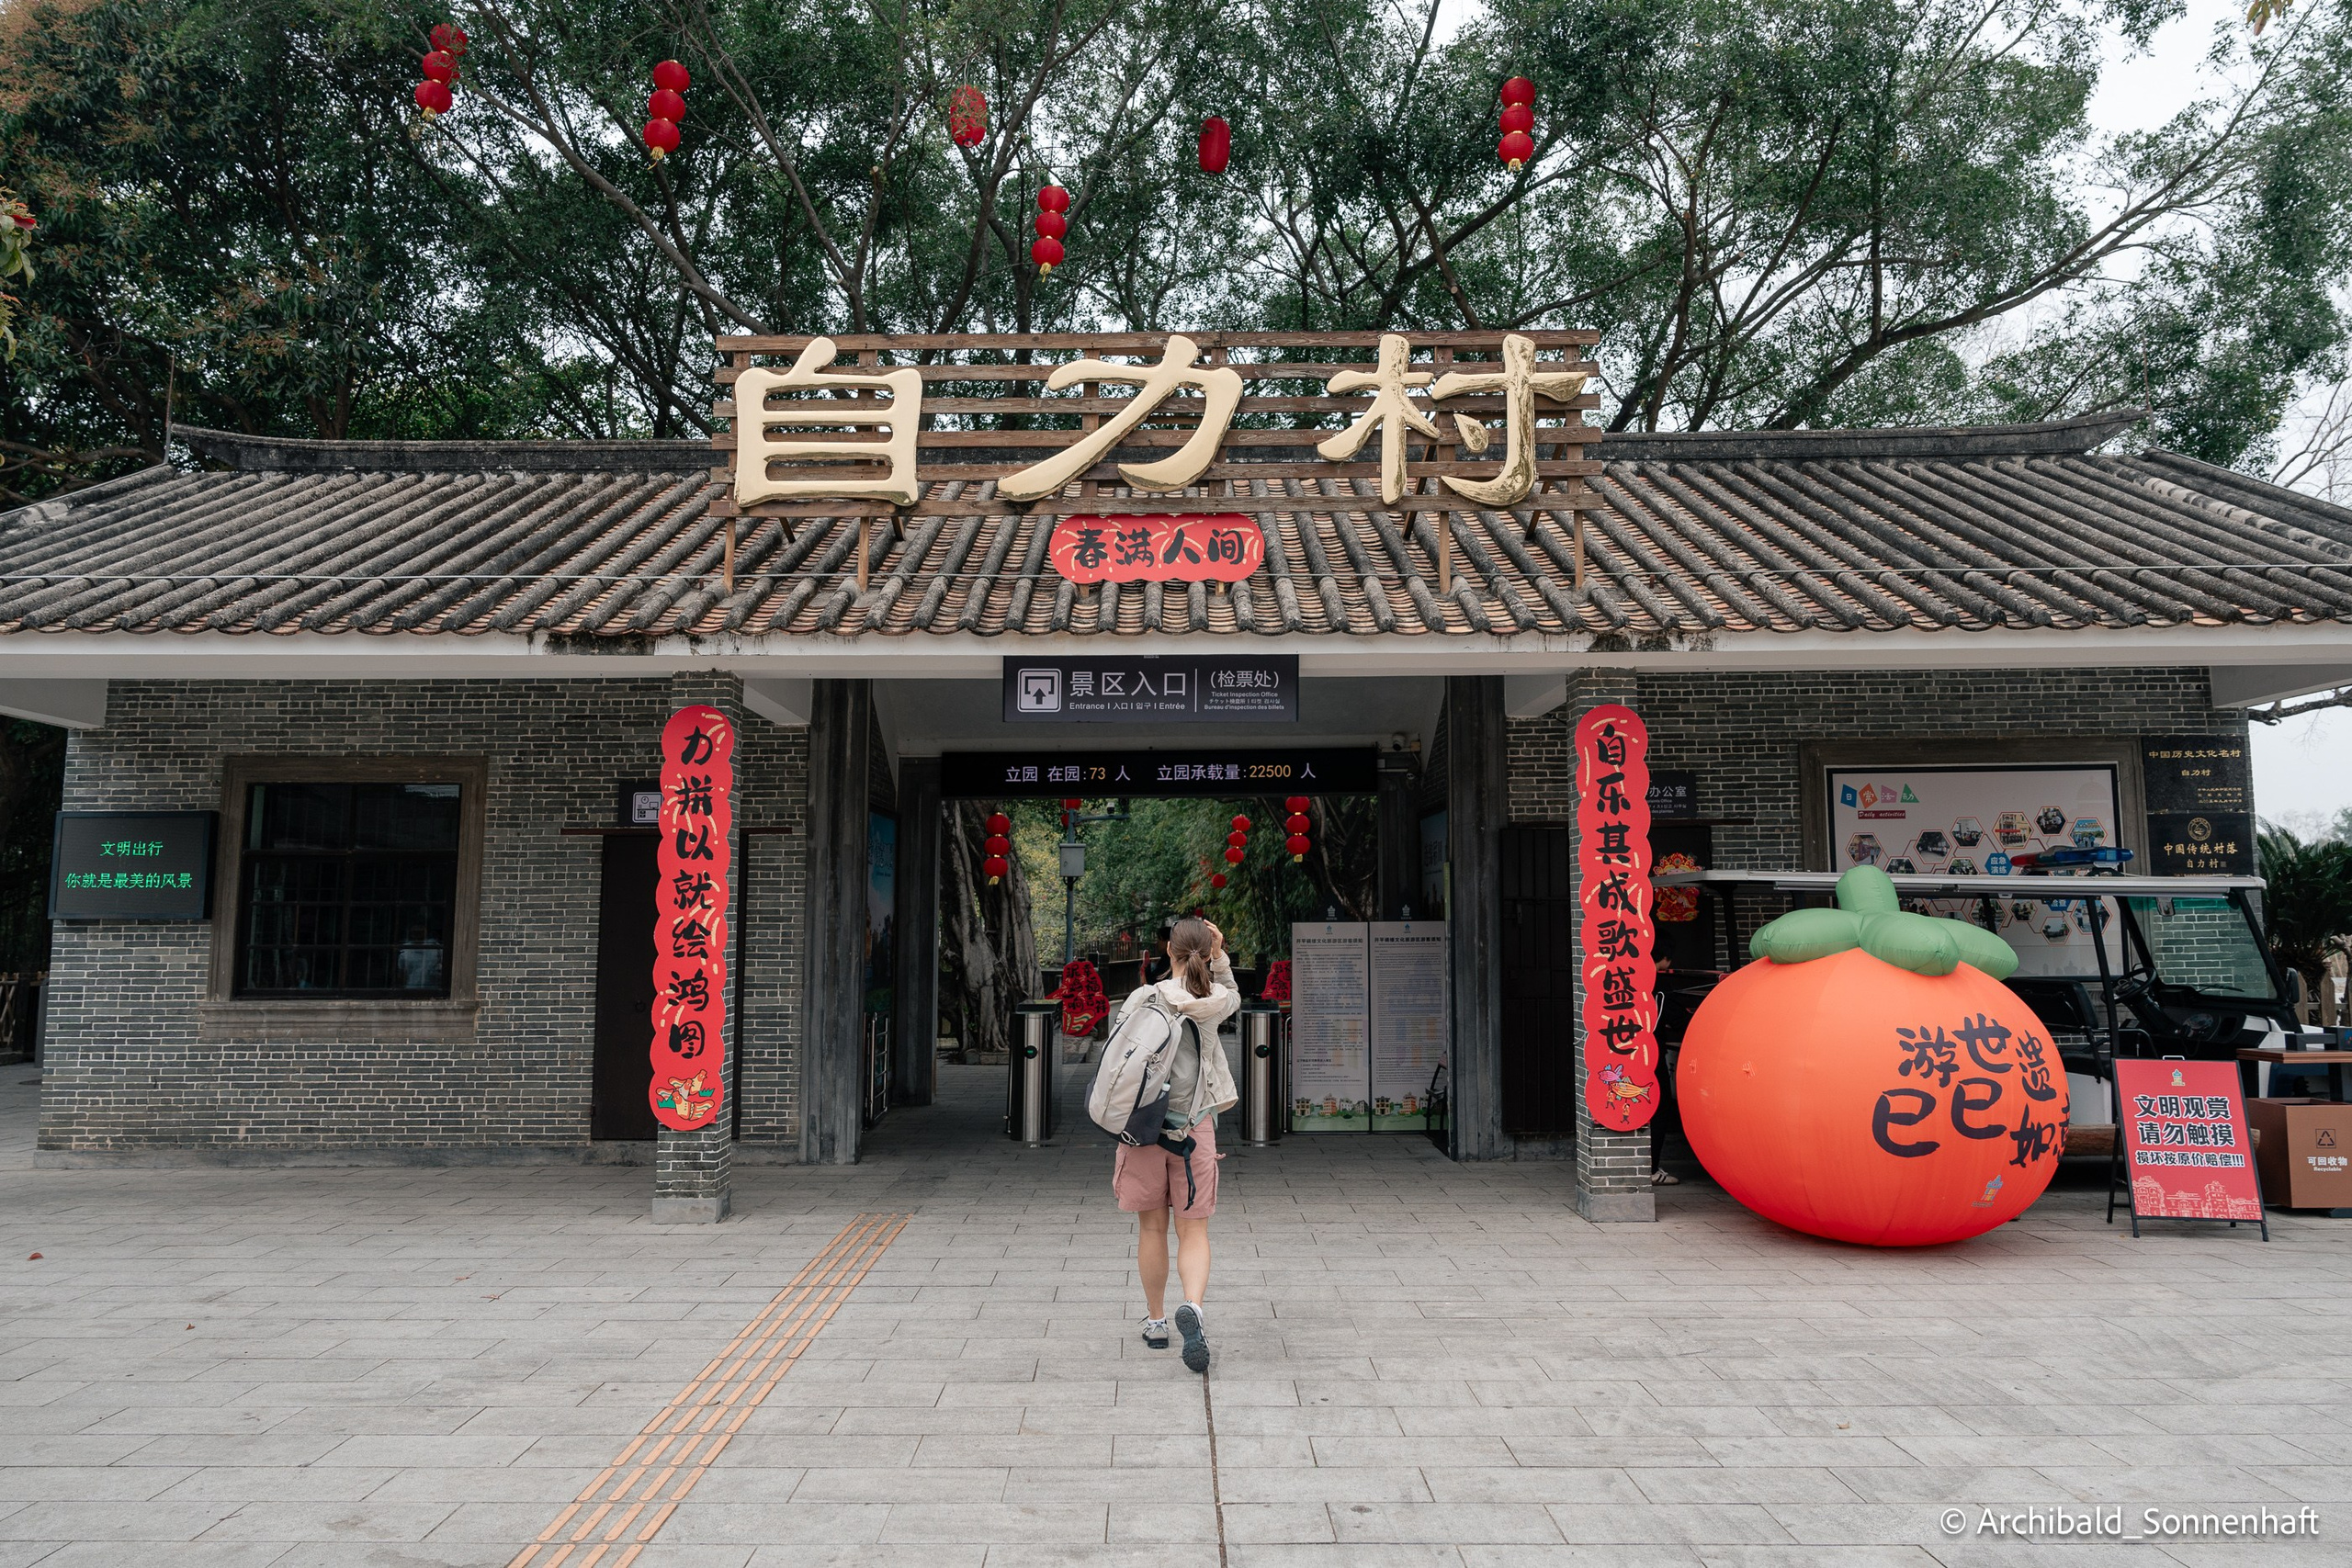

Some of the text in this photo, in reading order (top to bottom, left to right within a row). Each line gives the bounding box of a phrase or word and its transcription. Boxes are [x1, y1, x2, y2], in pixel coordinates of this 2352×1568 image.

[735, 333, 1589, 508] 自力村
[1073, 527, 1245, 570] 春满人间
[1069, 671, 1186, 696] 景区入口
[1210, 670, 1279, 688] (检票处)
[1113, 702, 1128, 710] 入口
[1136, 702, 1151, 710] 입구
[1159, 701, 1185, 710] Entrée
[2149, 750, 2242, 759] 中国历史文化名村
[1005, 765, 1038, 782] 立园
[1115, 765, 1131, 781] 人
[1300, 762, 1317, 779] 人
[1649, 785, 1688, 797] 办公室
[99, 840, 164, 857] 文明出行
[2164, 841, 2238, 855] 中国传统村落
[1990, 856, 2007, 865] 应急
[2187, 859, 2219, 868] 自力村
[65, 873, 193, 889] 你就是最美的风景
[1595, 724, 1644, 1055] 自乐其成歌盛世
[668, 727, 714, 1059] 力拼以就绘鸿图
[2134, 1095, 2231, 1119] 文明观赏
[2137, 1122, 2235, 1147] 请勿触摸
[2307, 1156, 2347, 1166] 可回收物
